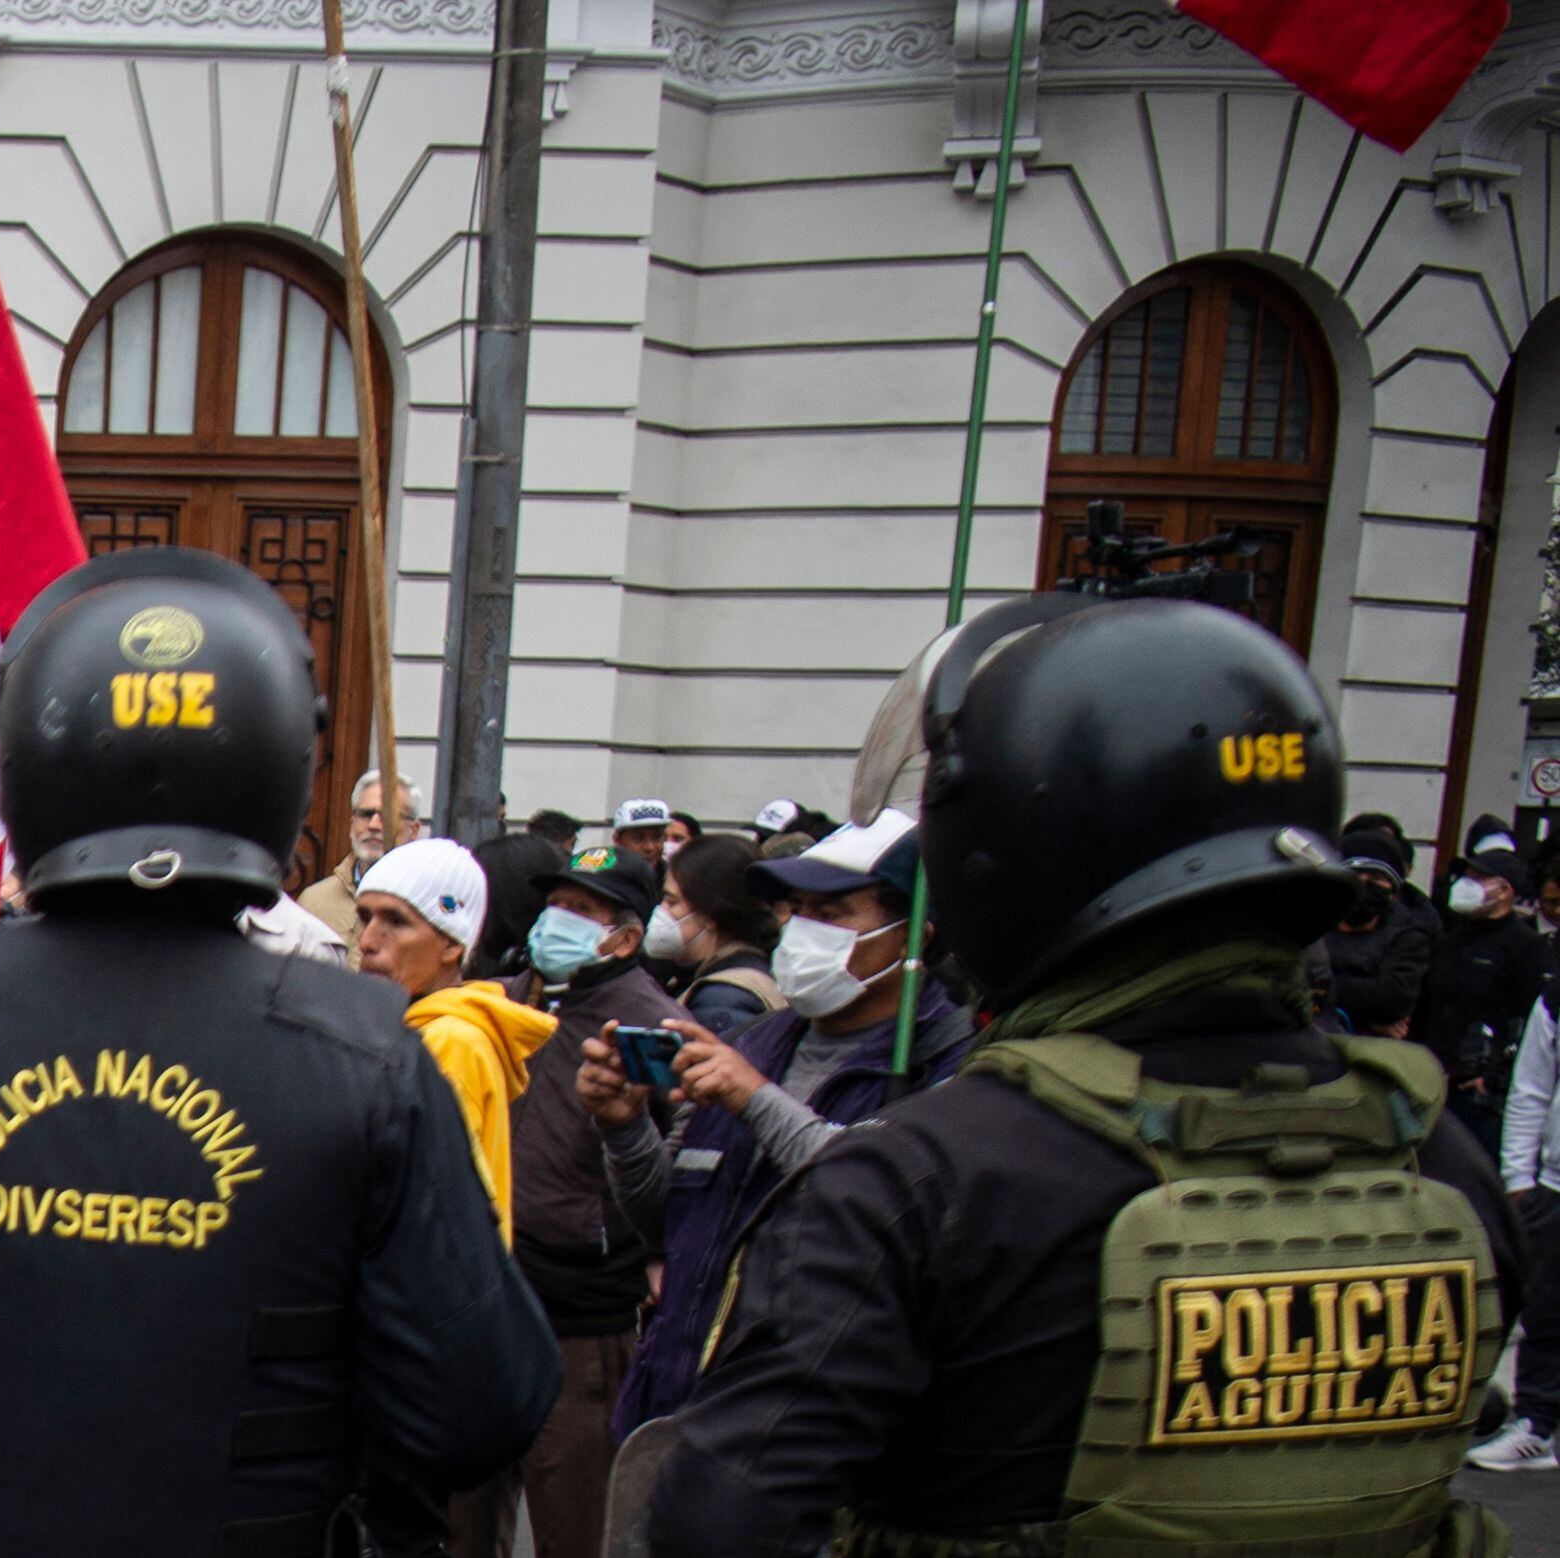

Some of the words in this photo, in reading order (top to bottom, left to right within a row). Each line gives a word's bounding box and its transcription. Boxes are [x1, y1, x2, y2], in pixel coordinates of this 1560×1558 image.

[110, 671, 215, 729] USE
[1218, 732, 1306, 783] USE
[94, 1049, 265, 1200] NACIONAL
[1173, 1275, 1463, 1384] POLICIA
[1169, 1364, 1460, 1432] AGUILAS
